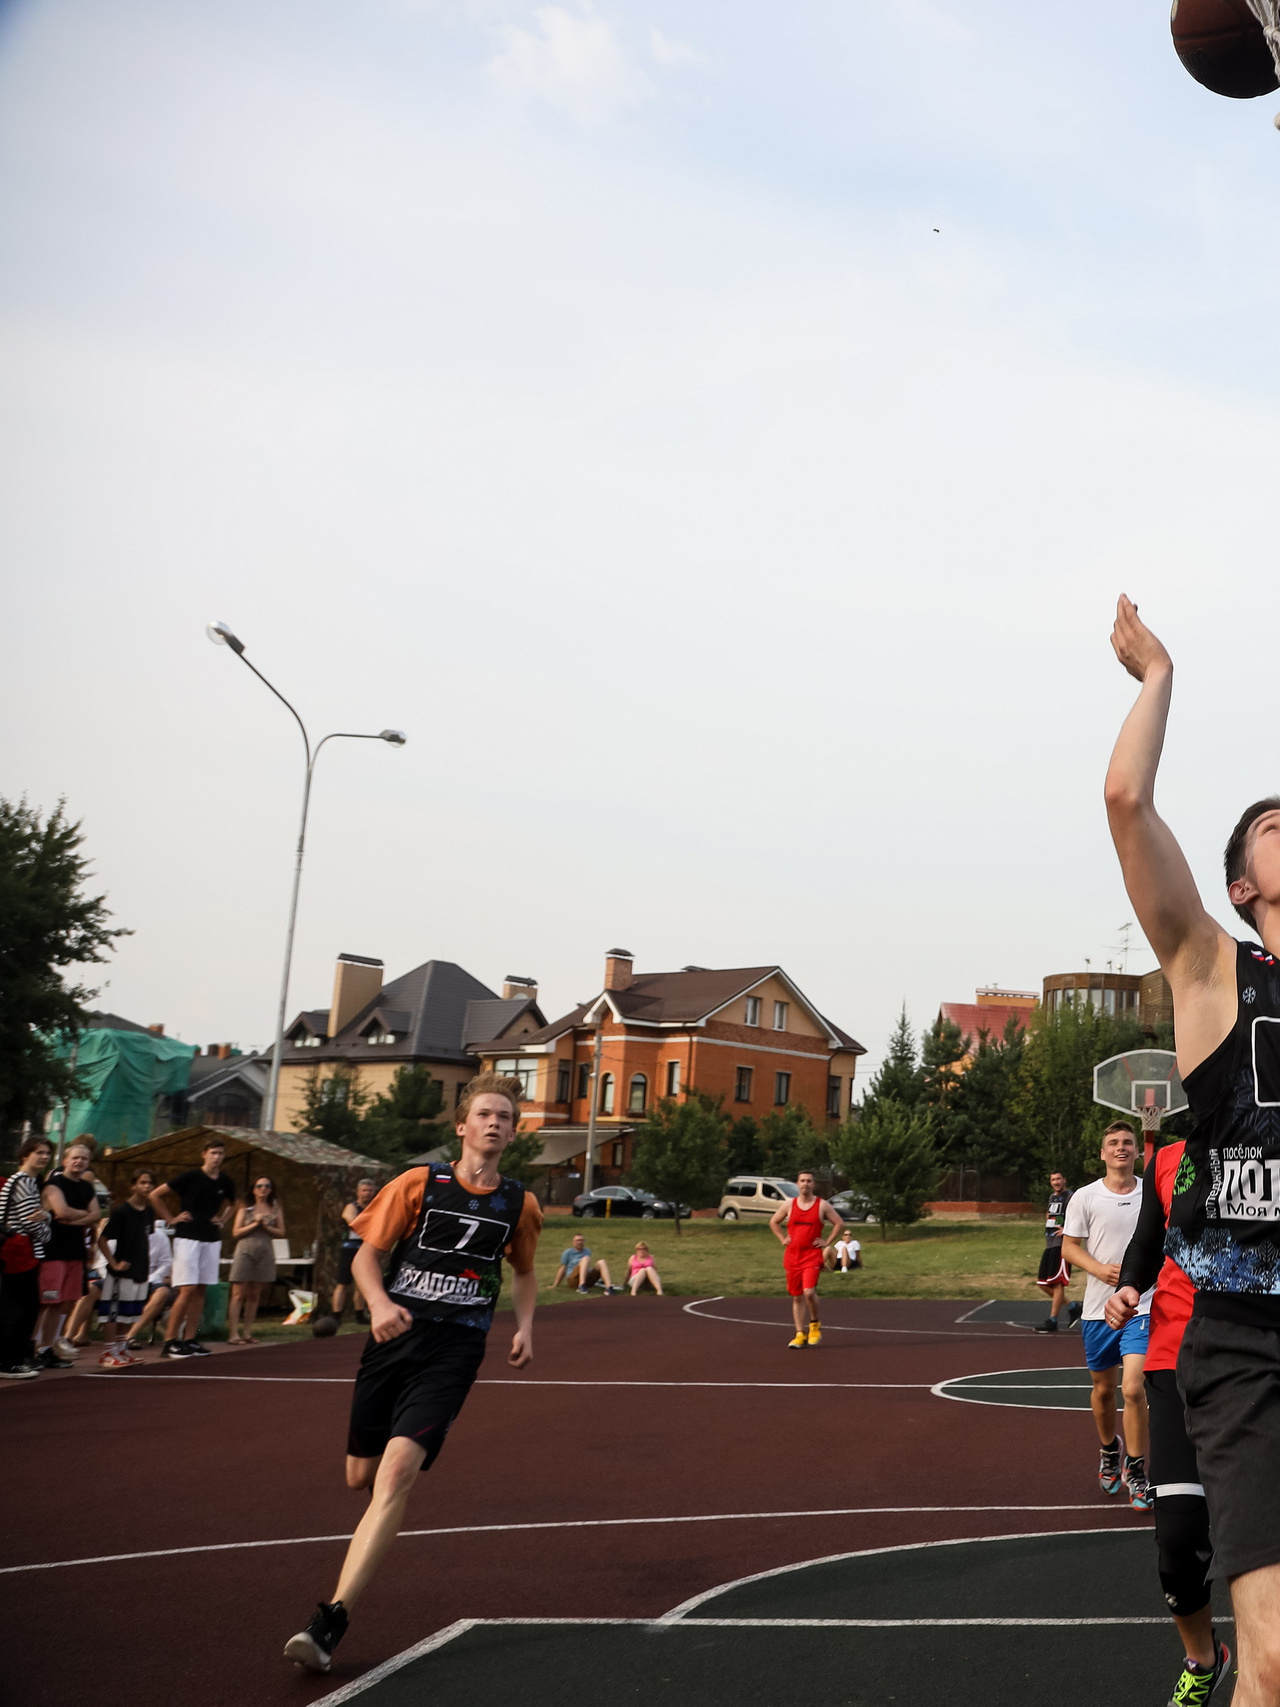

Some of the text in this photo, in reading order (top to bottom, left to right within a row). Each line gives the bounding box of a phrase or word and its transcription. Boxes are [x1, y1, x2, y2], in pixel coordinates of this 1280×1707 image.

[1222, 1142, 1263, 1160] посёлок
[1227, 1201, 1269, 1217] Моя
[453, 1217, 480, 1250] 7
